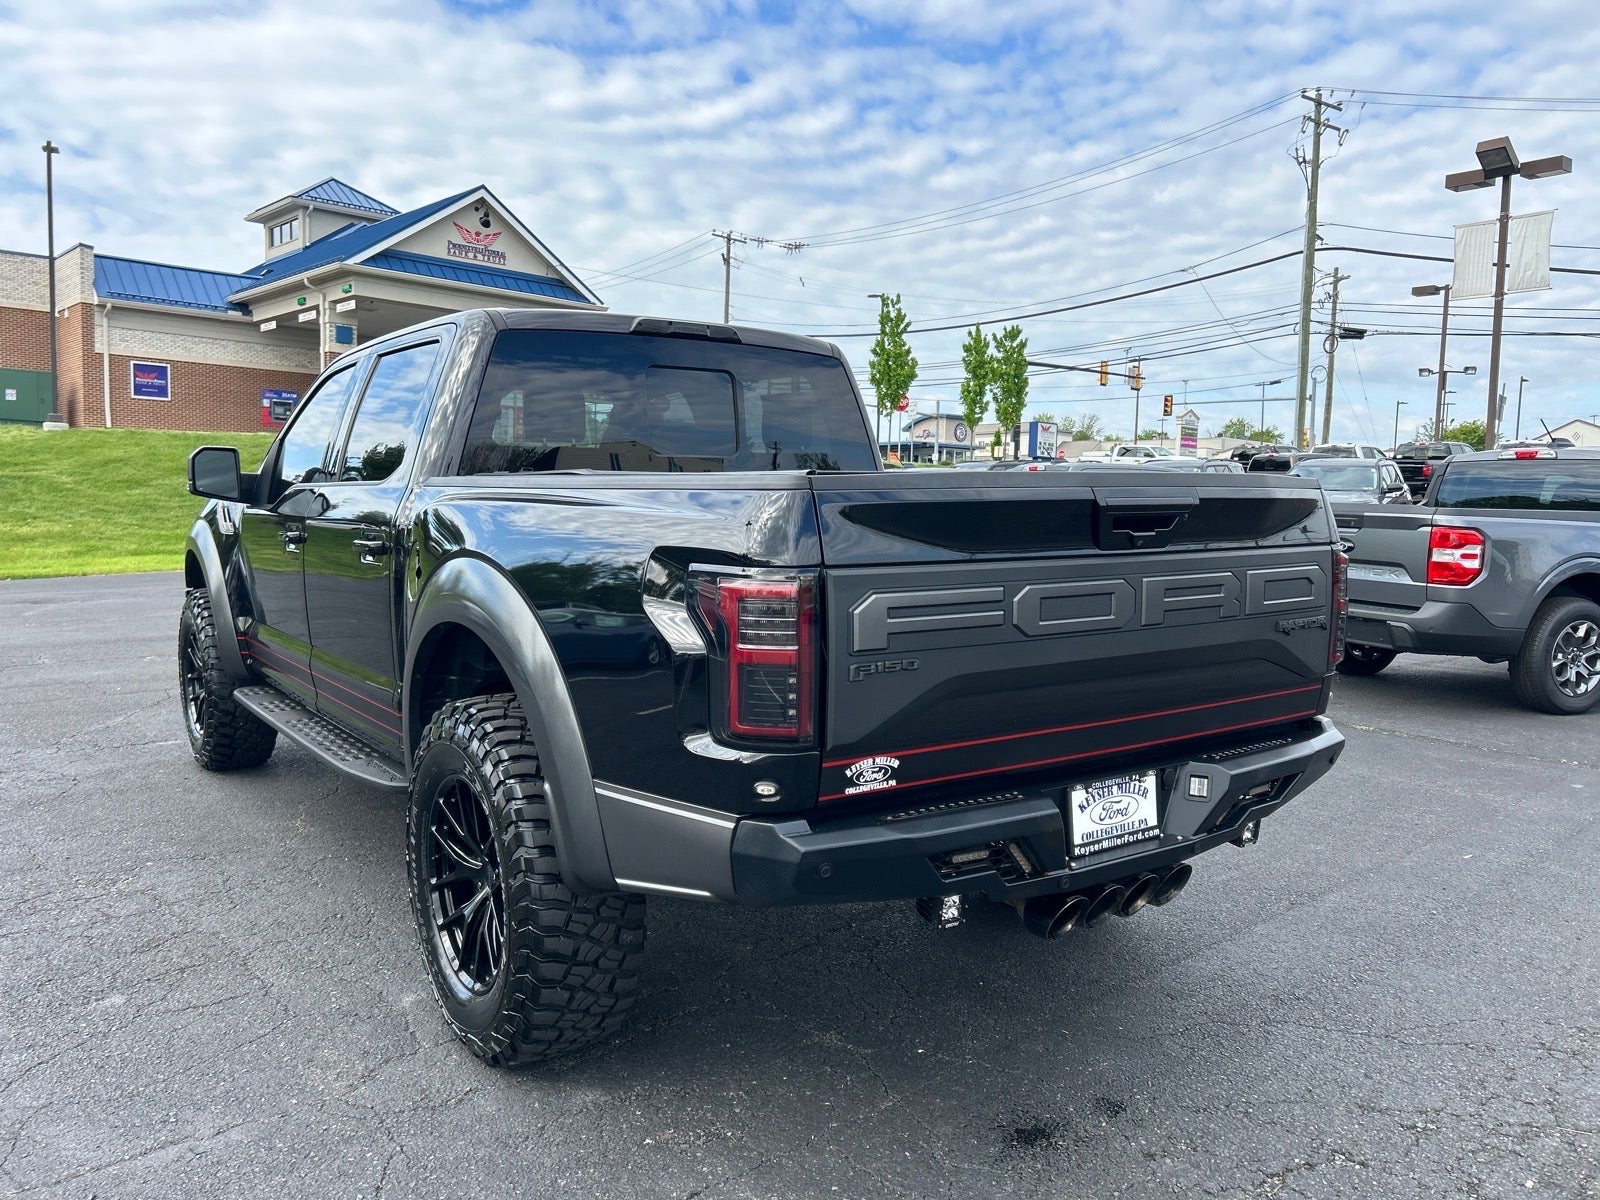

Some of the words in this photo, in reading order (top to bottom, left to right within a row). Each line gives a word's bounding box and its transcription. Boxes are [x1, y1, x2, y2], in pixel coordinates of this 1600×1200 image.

[851, 564, 1327, 652] FORD
[1275, 615, 1327, 636] RAPTOR
[845, 758, 873, 778] KEYSER
[875, 756, 900, 768] MILLER
[859, 767, 885, 782] Ford
[1078, 786, 1114, 814] KEYSER
[1116, 782, 1149, 799] MILLER
[1098, 799, 1131, 822] Ford
[1074, 828, 1160, 856] KeyserMillerFord.com
